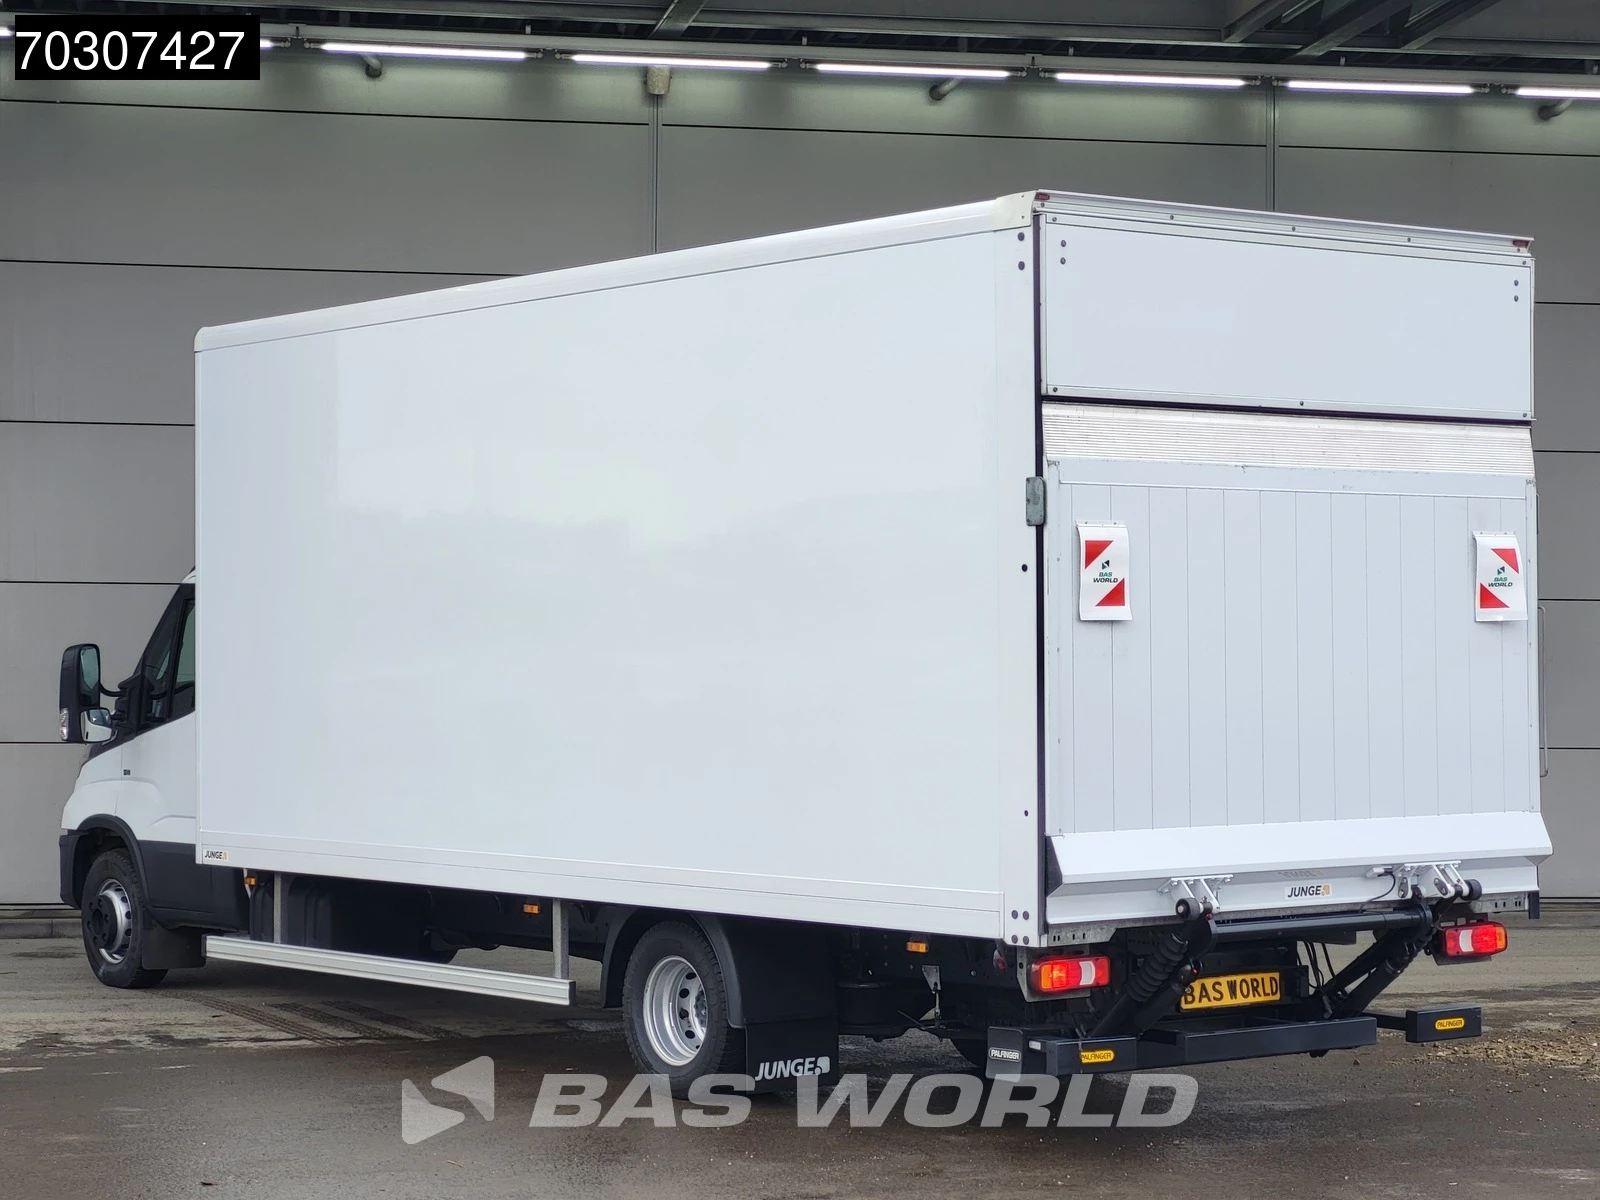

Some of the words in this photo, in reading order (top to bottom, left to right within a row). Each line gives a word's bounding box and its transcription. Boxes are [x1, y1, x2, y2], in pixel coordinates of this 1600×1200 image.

[204, 850, 223, 860] JUNGE
[1287, 884, 1322, 898] JUNGE
[1184, 980, 1225, 1005] BAS
[1226, 976, 1279, 1000] WORLD
[990, 1049, 1020, 1060] PALFINGER
[1081, 1052, 1112, 1061] PALFINGER
[754, 1057, 816, 1081] JUNGE
